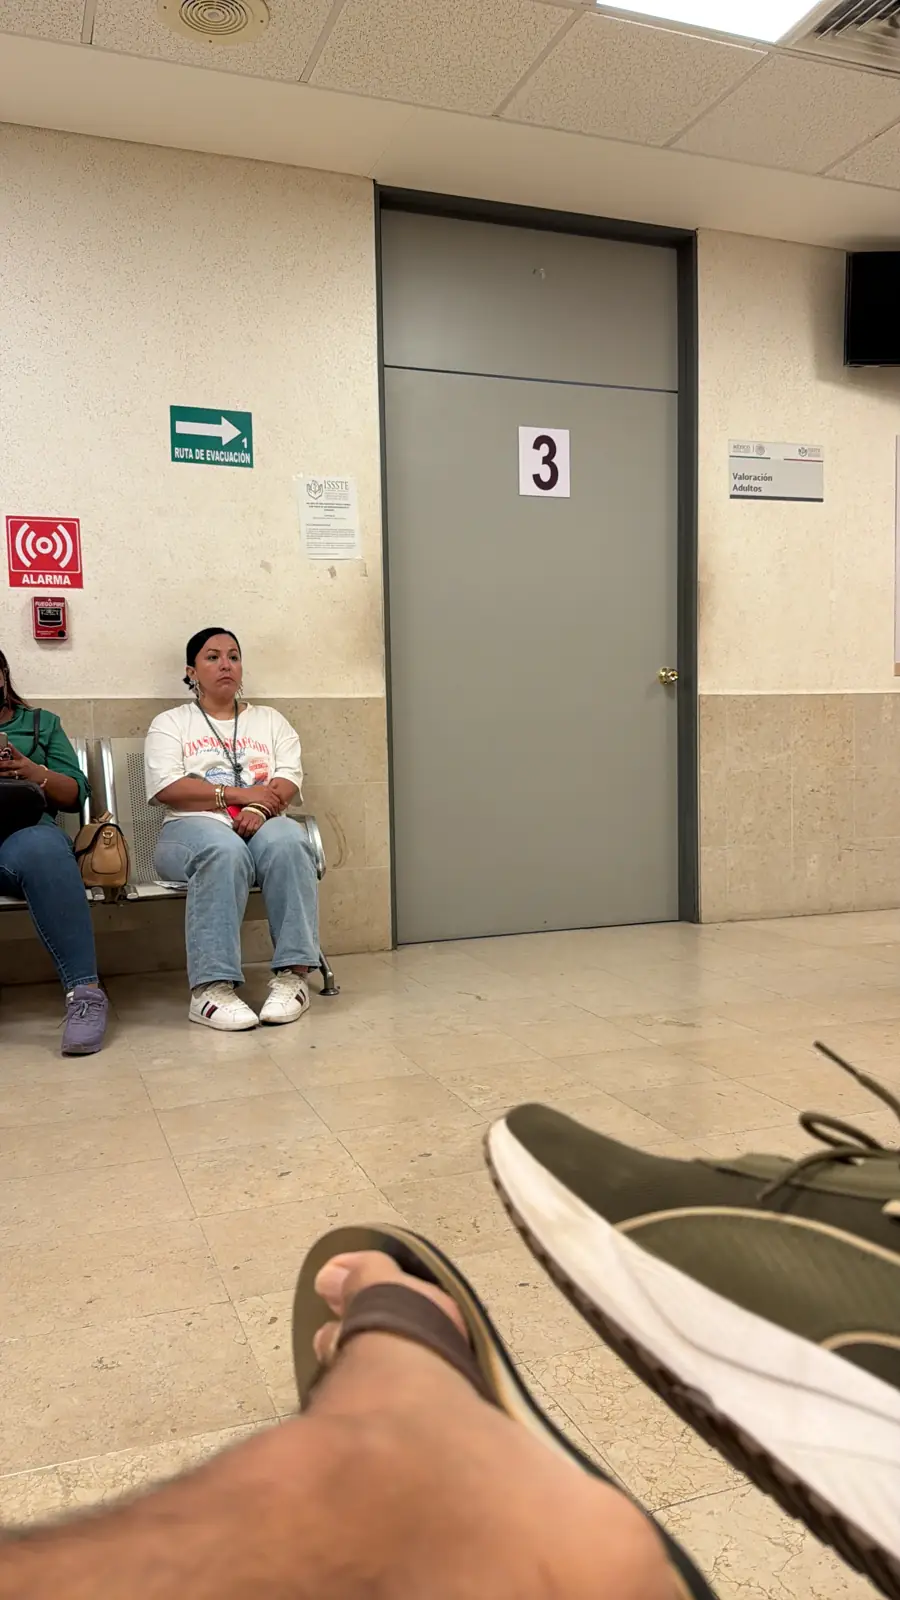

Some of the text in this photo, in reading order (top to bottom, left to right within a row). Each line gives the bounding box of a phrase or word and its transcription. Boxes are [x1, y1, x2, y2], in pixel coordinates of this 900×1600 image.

[242, 437, 248, 449] 1
[174, 447, 251, 464] RUTA DE EVACUACIÓN
[532, 434, 559, 491] 3
[732, 473, 773, 482] Valoración
[323, 479, 349, 490] ISSSTE
[732, 484, 763, 492] Adultos
[22, 574, 72, 586] ALARMA
